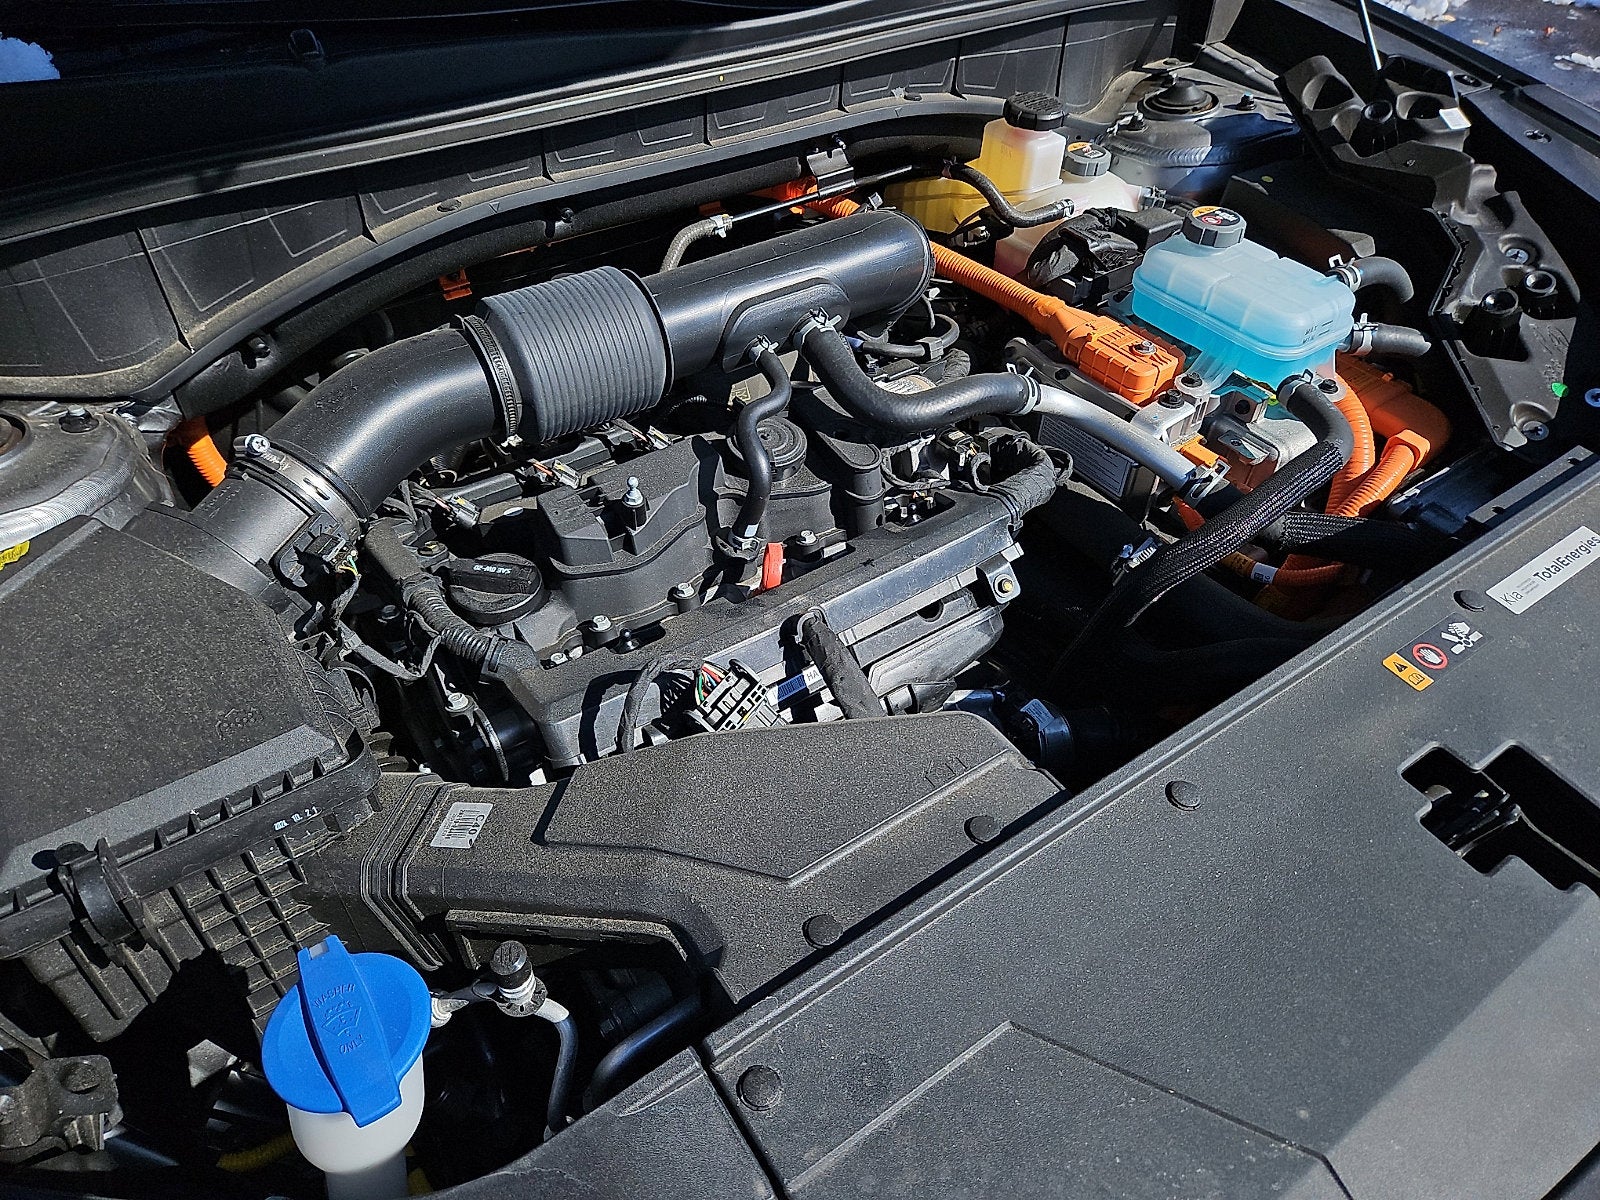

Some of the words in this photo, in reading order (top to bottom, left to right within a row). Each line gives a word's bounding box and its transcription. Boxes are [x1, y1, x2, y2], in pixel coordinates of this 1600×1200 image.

[1500, 590, 1524, 605] Kia
[1533, 535, 1600, 583] TotalEnergies
[313, 983, 356, 1008] WASHER
[339, 1034, 366, 1055] ONLY
